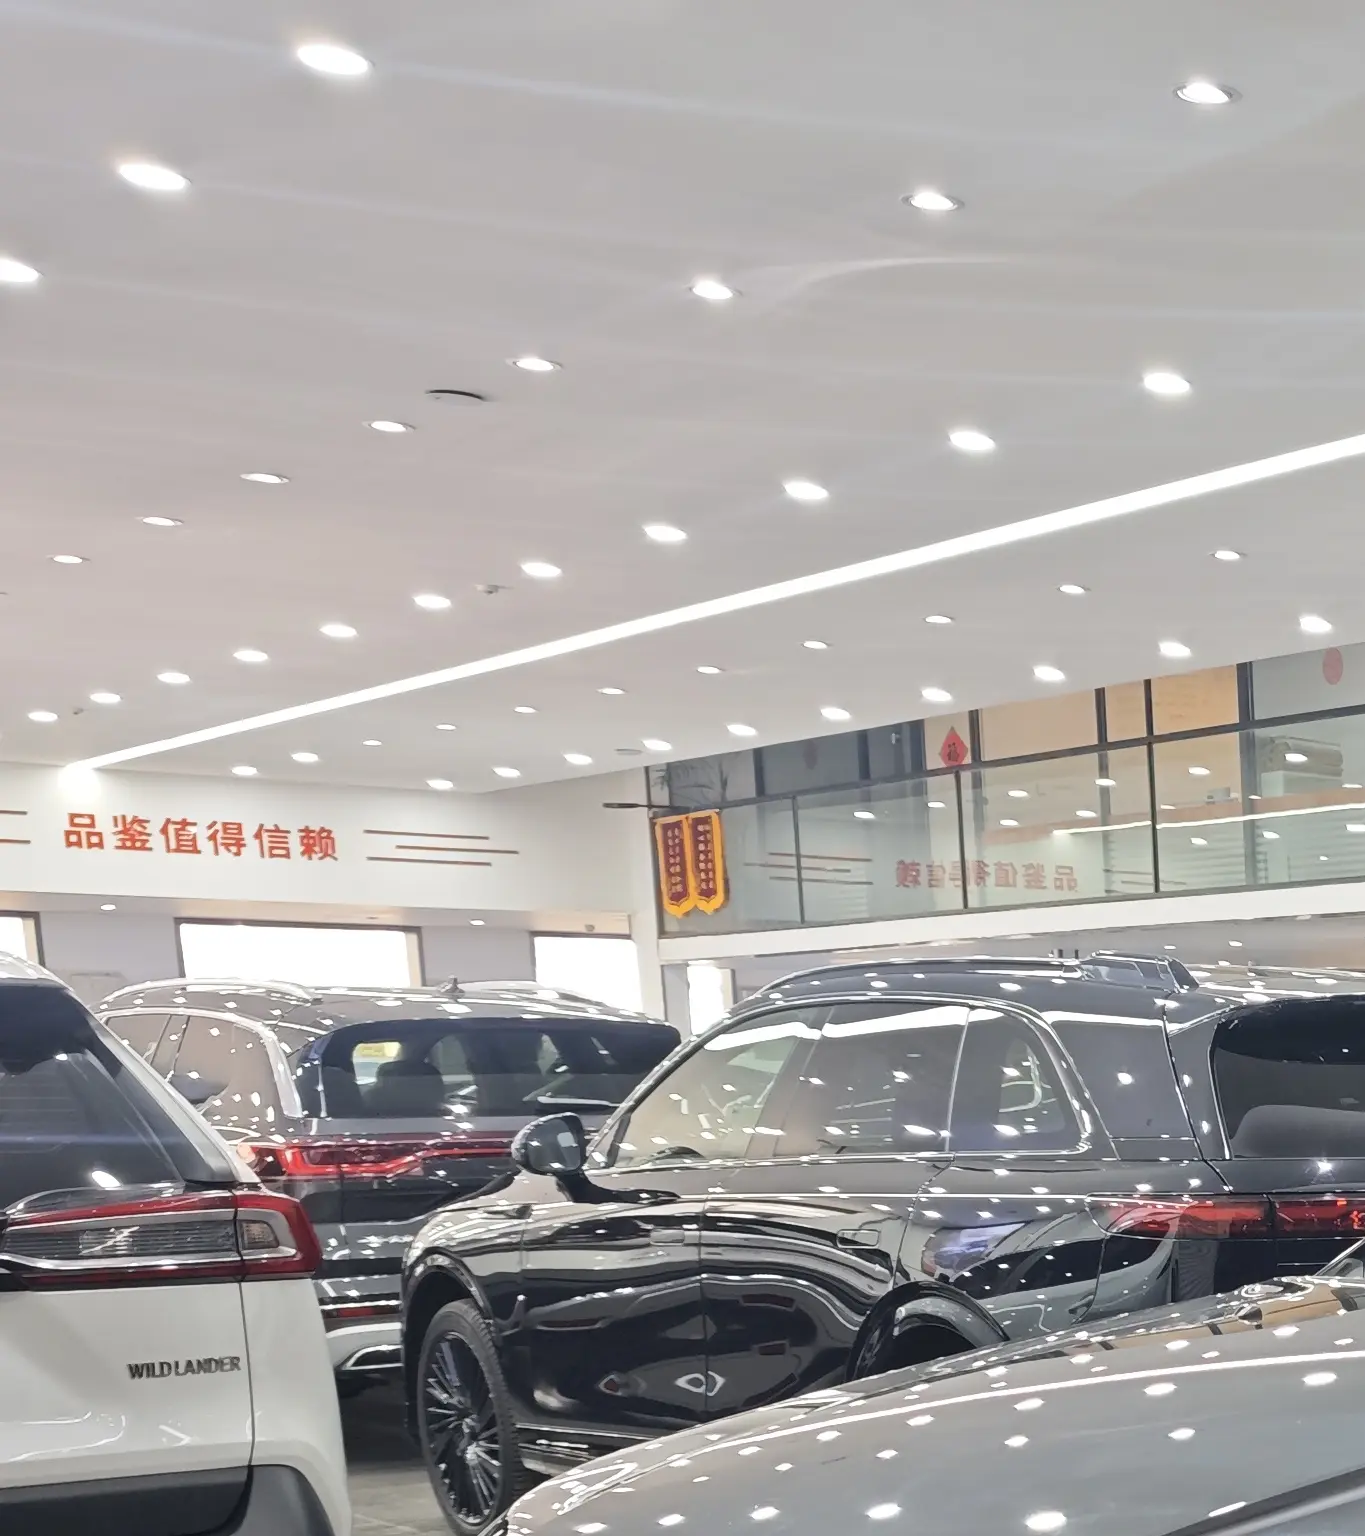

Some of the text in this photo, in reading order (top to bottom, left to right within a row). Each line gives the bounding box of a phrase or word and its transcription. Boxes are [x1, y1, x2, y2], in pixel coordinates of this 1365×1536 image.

[63, 811, 340, 863] 品鉴值得信赖
